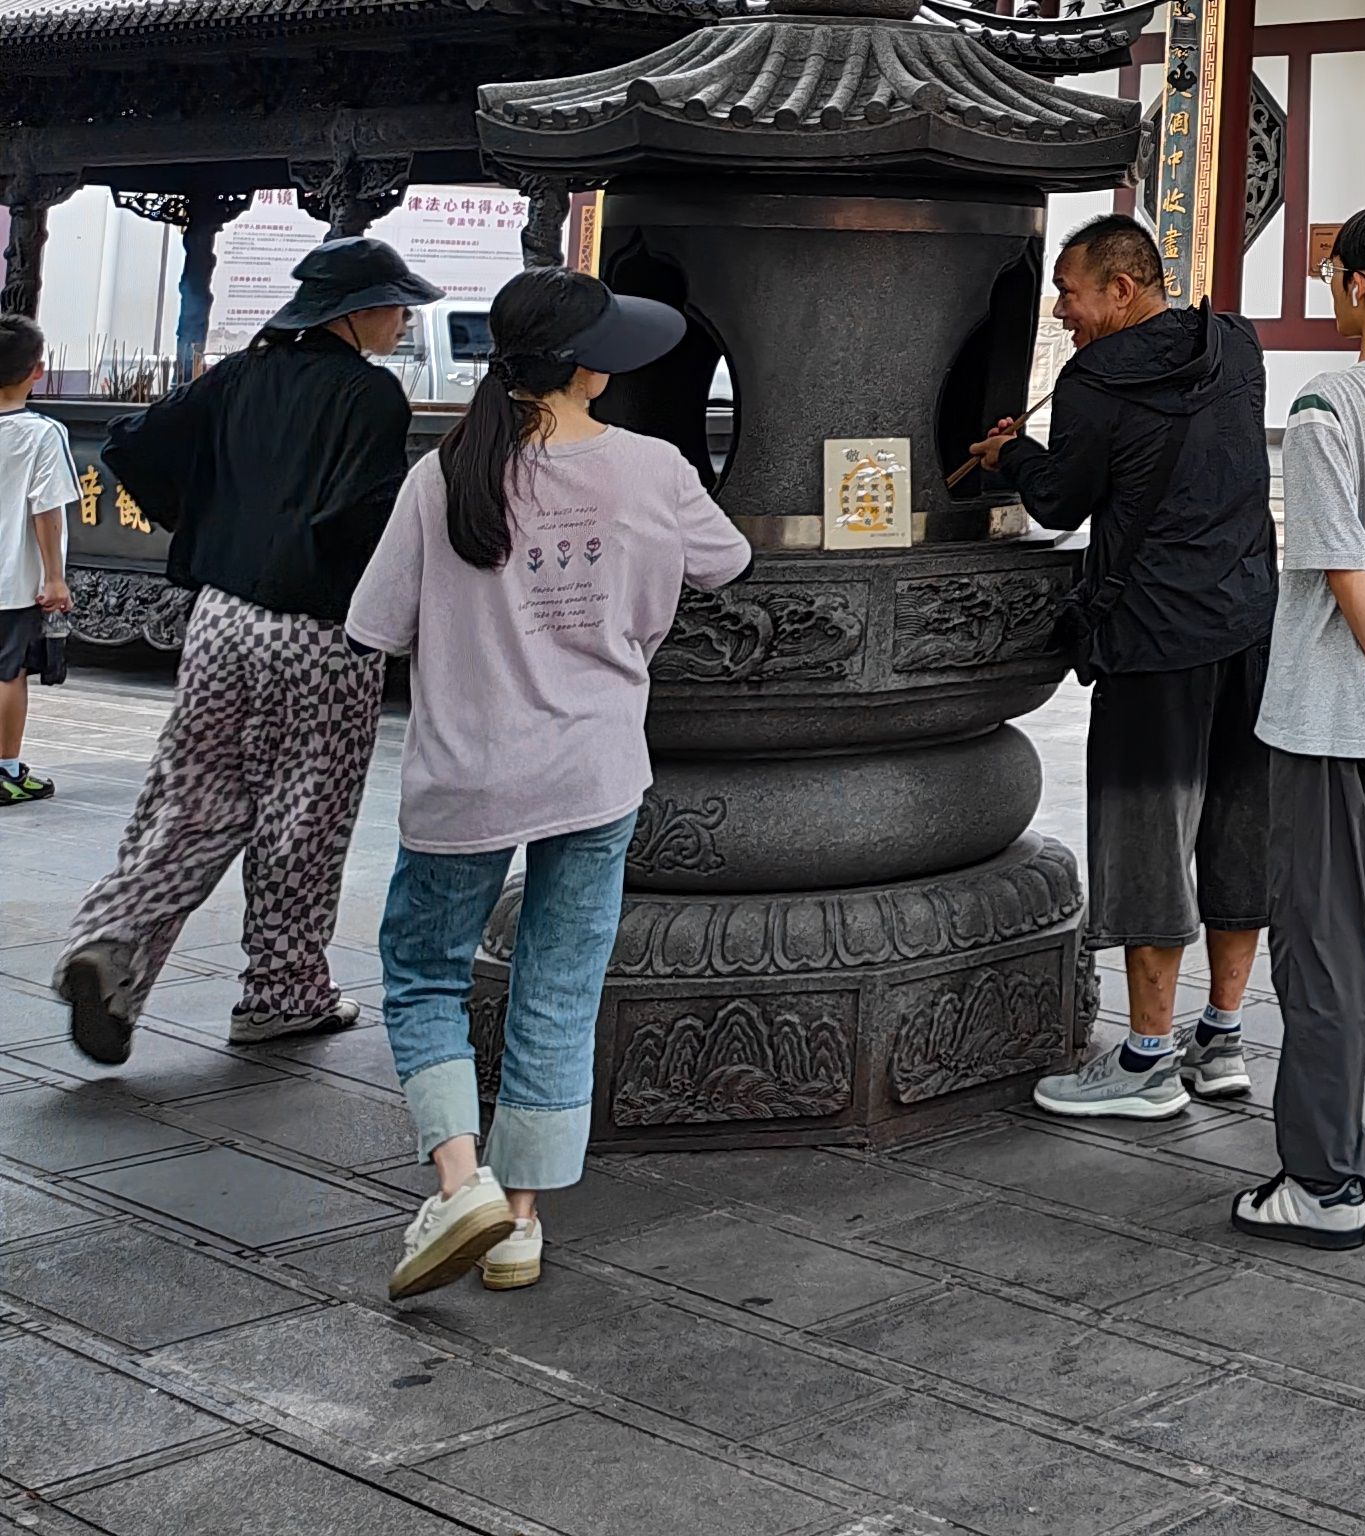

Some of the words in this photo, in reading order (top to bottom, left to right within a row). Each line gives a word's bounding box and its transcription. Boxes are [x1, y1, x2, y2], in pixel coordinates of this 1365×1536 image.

[407, 195, 527, 216] 律法心中得心安
